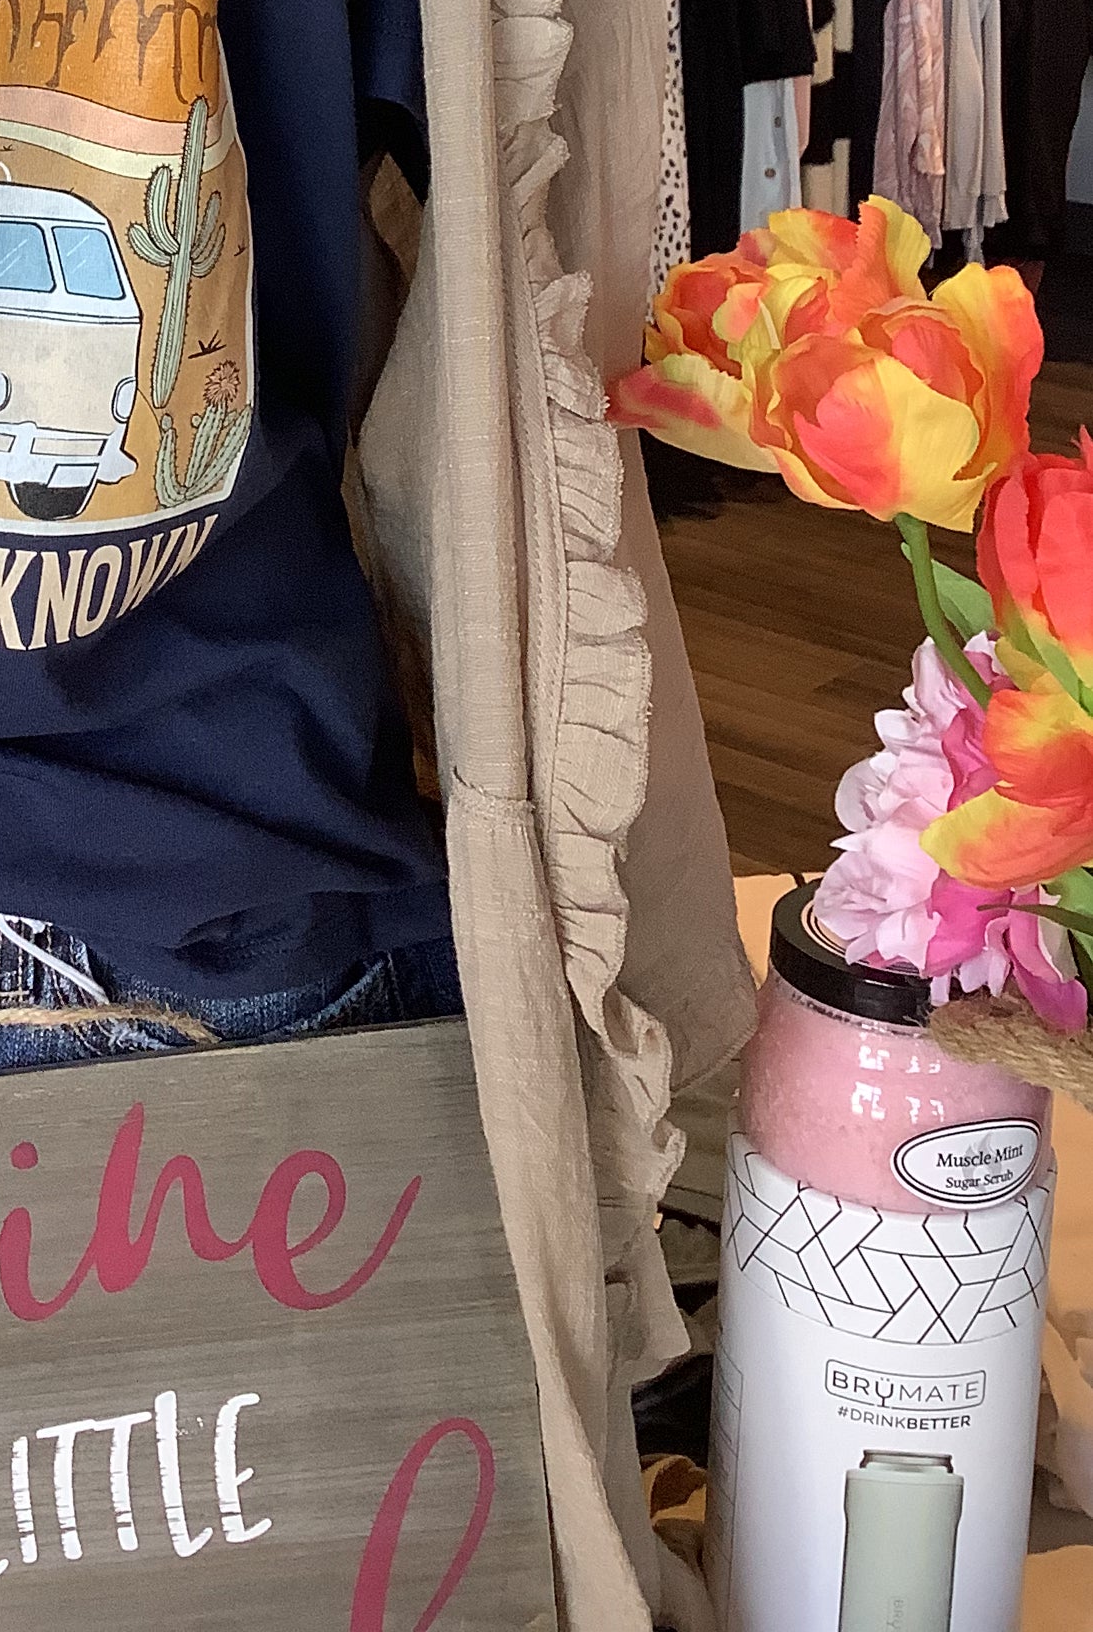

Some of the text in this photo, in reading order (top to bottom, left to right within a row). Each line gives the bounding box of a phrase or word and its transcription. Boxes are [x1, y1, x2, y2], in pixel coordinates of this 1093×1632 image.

[936, 1144, 1024, 1168] Muscle Mint
[946, 1169, 1014, 1191] Sugar Scrub
[837, 1405, 971, 1431] #DRINKBETTER
